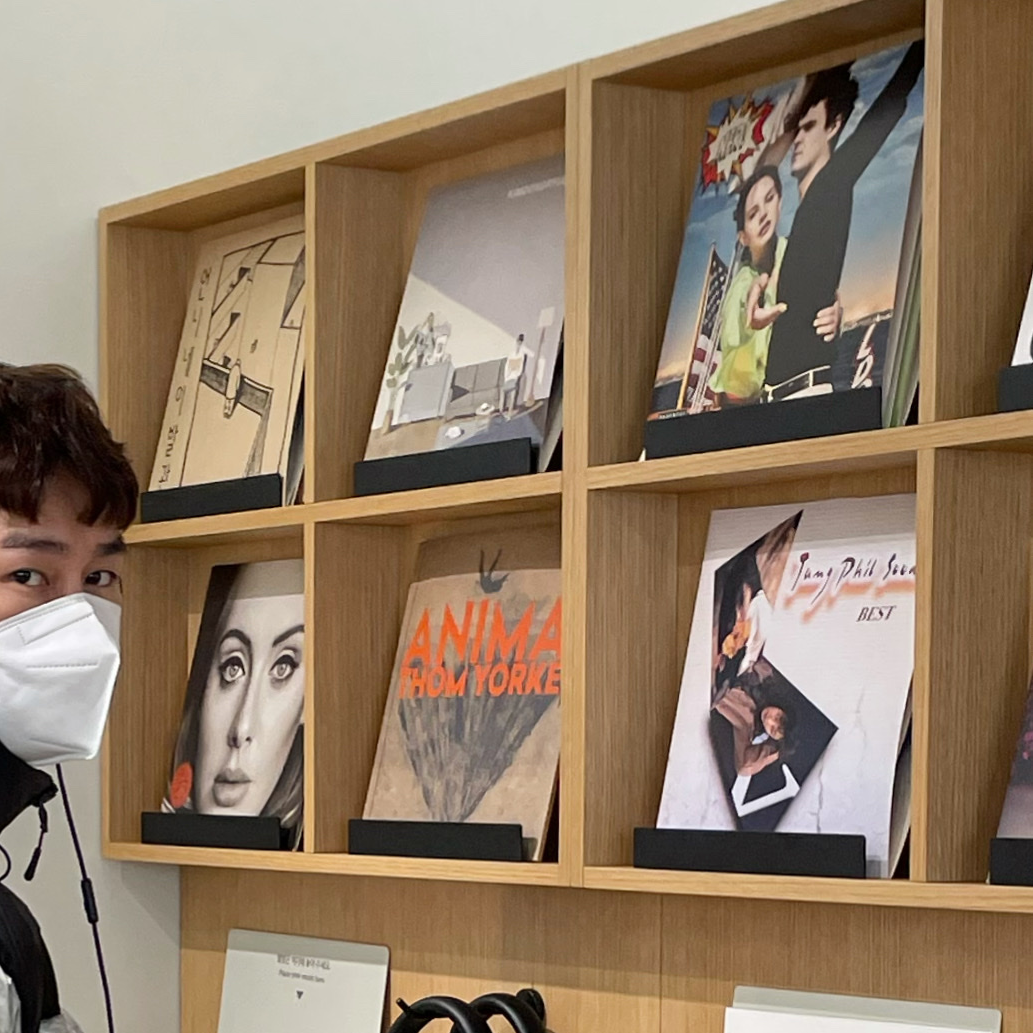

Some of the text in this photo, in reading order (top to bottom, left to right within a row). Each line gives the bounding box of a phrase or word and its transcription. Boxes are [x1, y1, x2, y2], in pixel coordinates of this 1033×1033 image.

[401, 594, 562, 668] ANIMA
[856, 605, 897, 622] BEST
[398, 662, 562, 699] THOM YORKE
